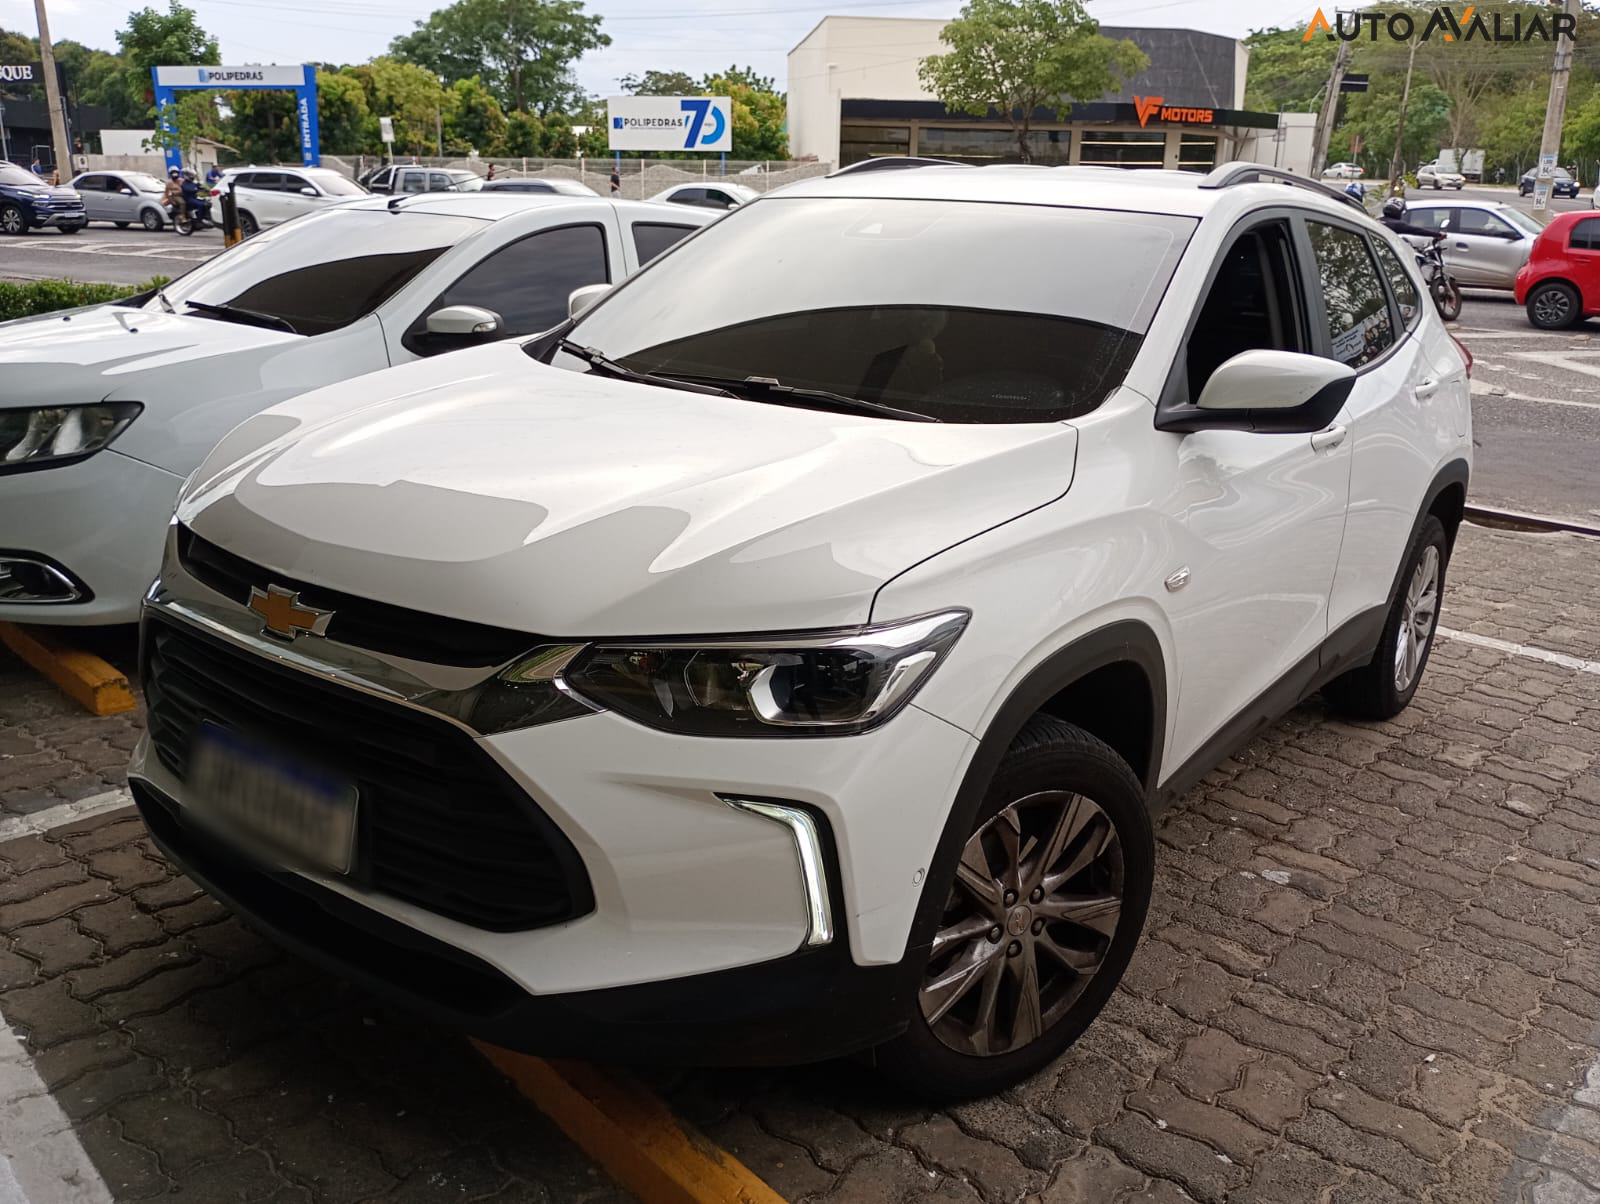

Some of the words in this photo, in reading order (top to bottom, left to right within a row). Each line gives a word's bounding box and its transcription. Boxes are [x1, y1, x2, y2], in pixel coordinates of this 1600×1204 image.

[208, 71, 263, 81] POLIPEDRAS
[1161, 107, 1214, 123] MOTORS
[300, 97, 311, 148] ENTRADA
[624, 118, 683, 127] POLIPEDRAS
